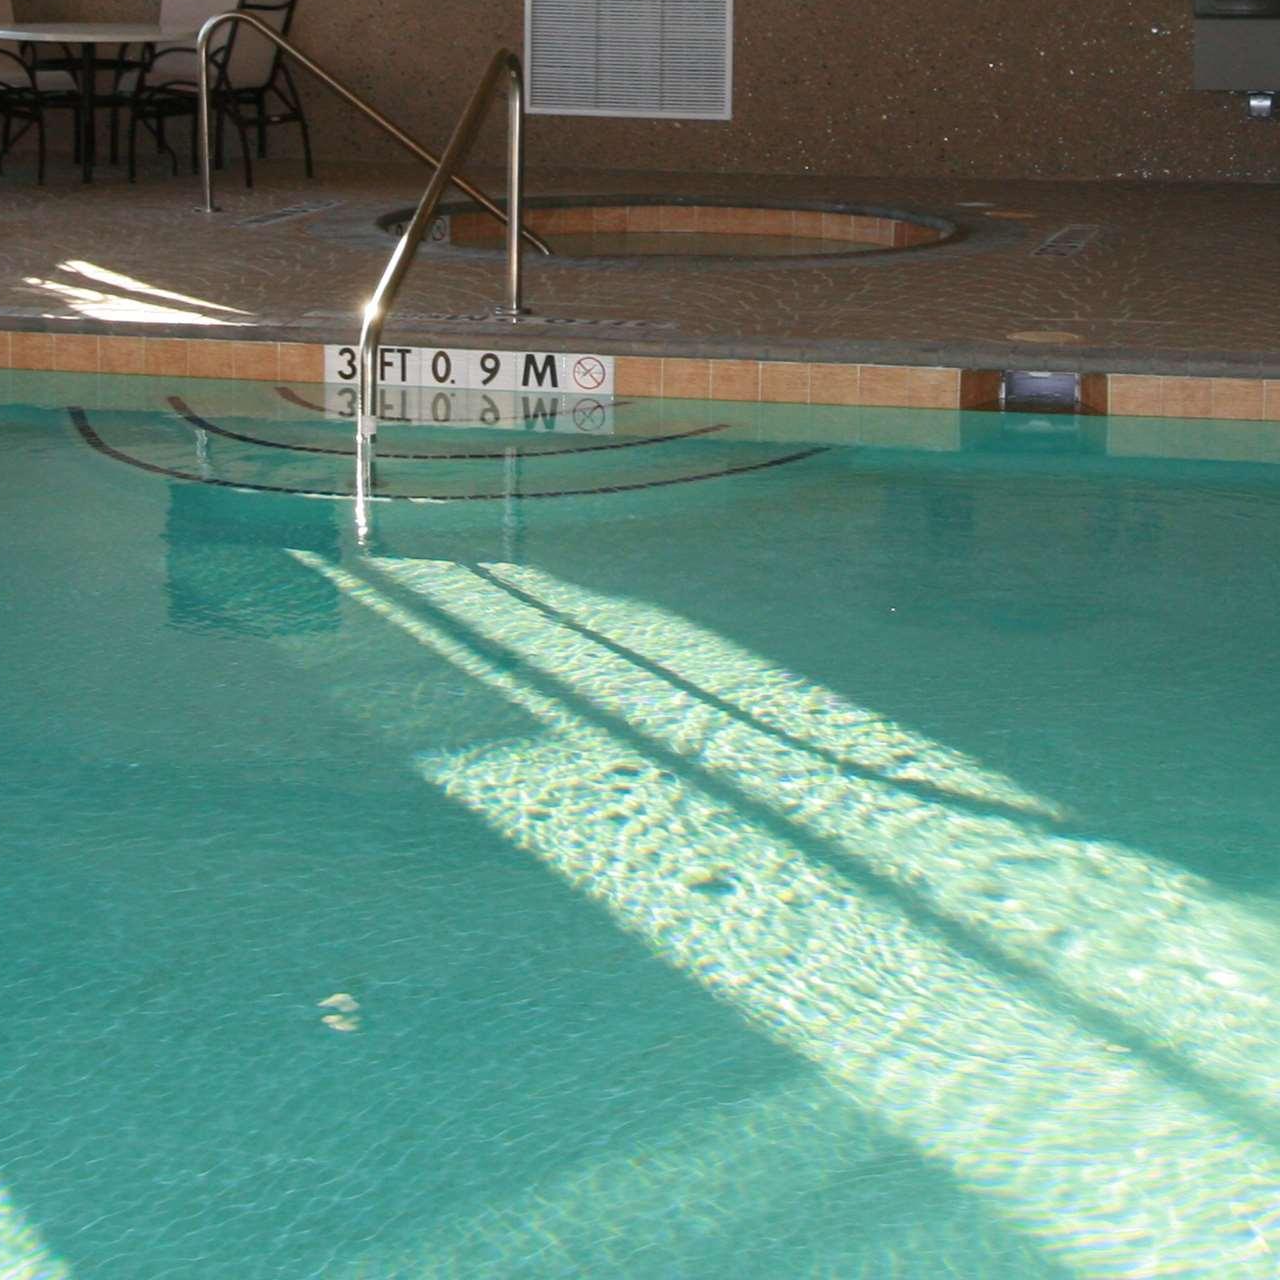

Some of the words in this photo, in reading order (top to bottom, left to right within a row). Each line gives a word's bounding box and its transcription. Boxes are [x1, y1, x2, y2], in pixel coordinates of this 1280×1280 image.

[338, 347, 357, 380] 3
[380, 348, 411, 382] FT
[522, 354, 558, 388] M
